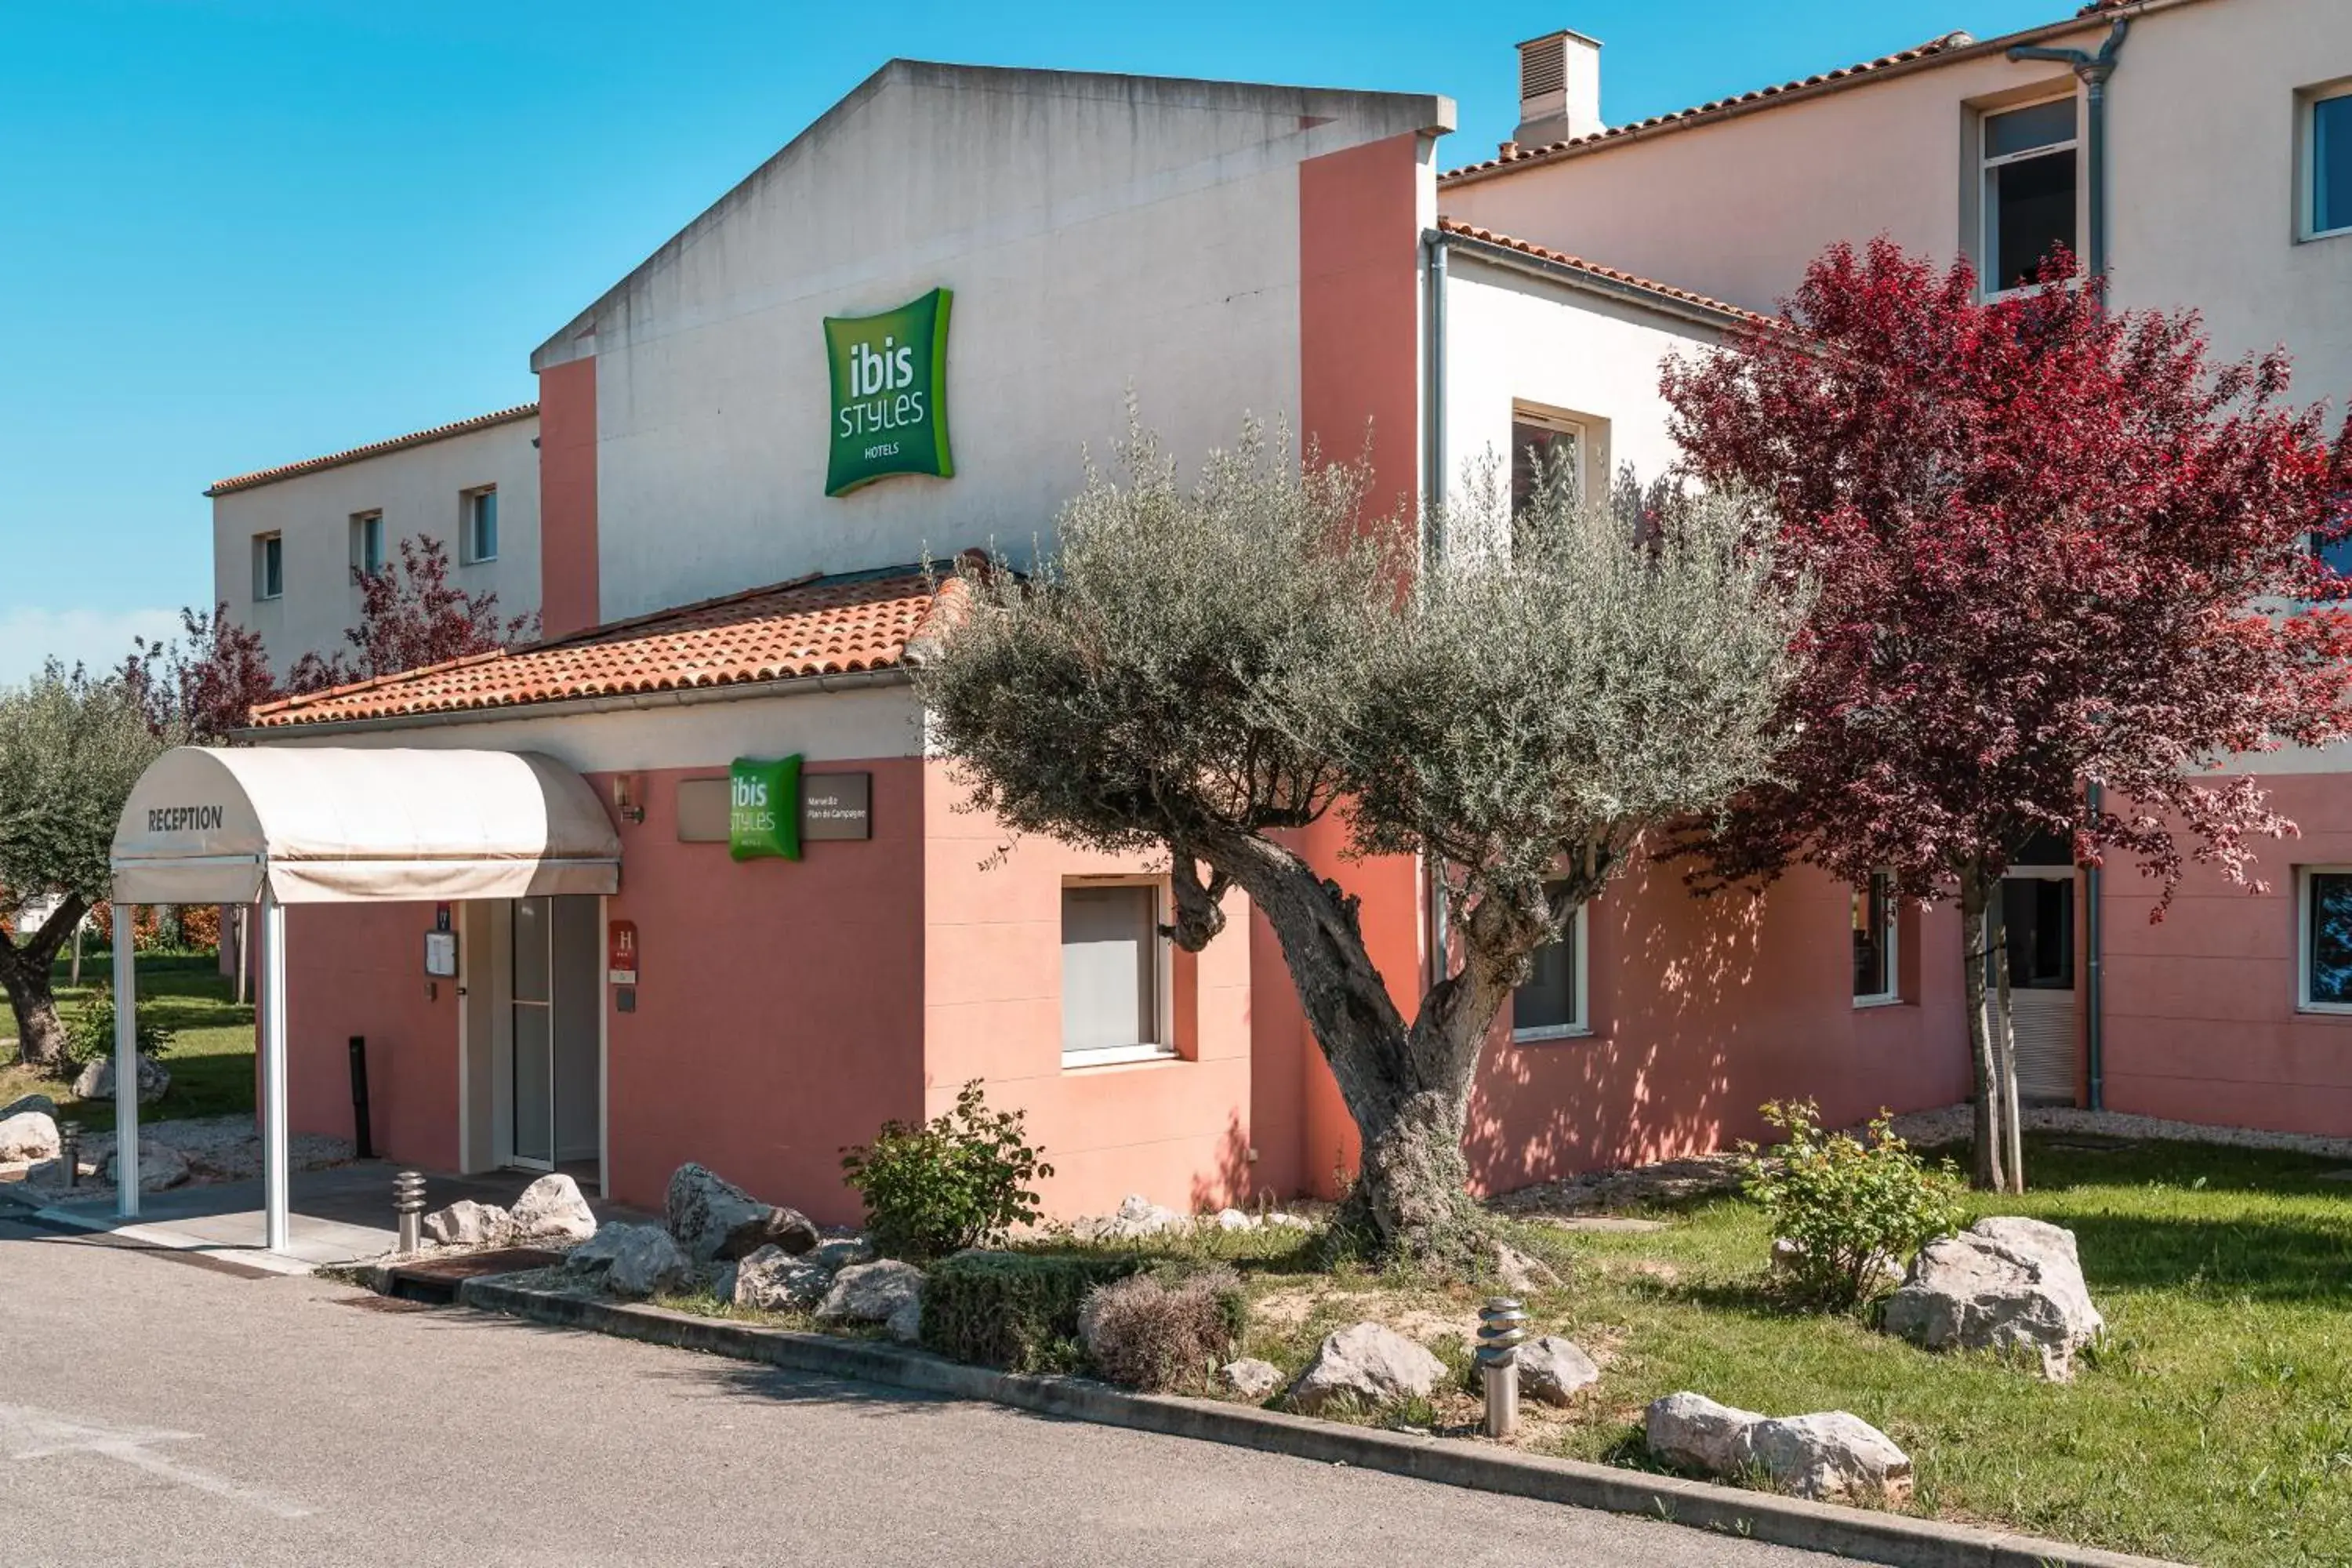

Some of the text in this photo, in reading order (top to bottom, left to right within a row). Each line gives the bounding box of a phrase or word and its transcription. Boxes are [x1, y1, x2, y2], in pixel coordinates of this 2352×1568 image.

[851, 337, 913, 397] ibis
[865, 442, 899, 459] HOTELS
[732, 775, 767, 807] ibis
[148, 805, 223, 833] RECEPTION
[620, 931, 631, 949] H
